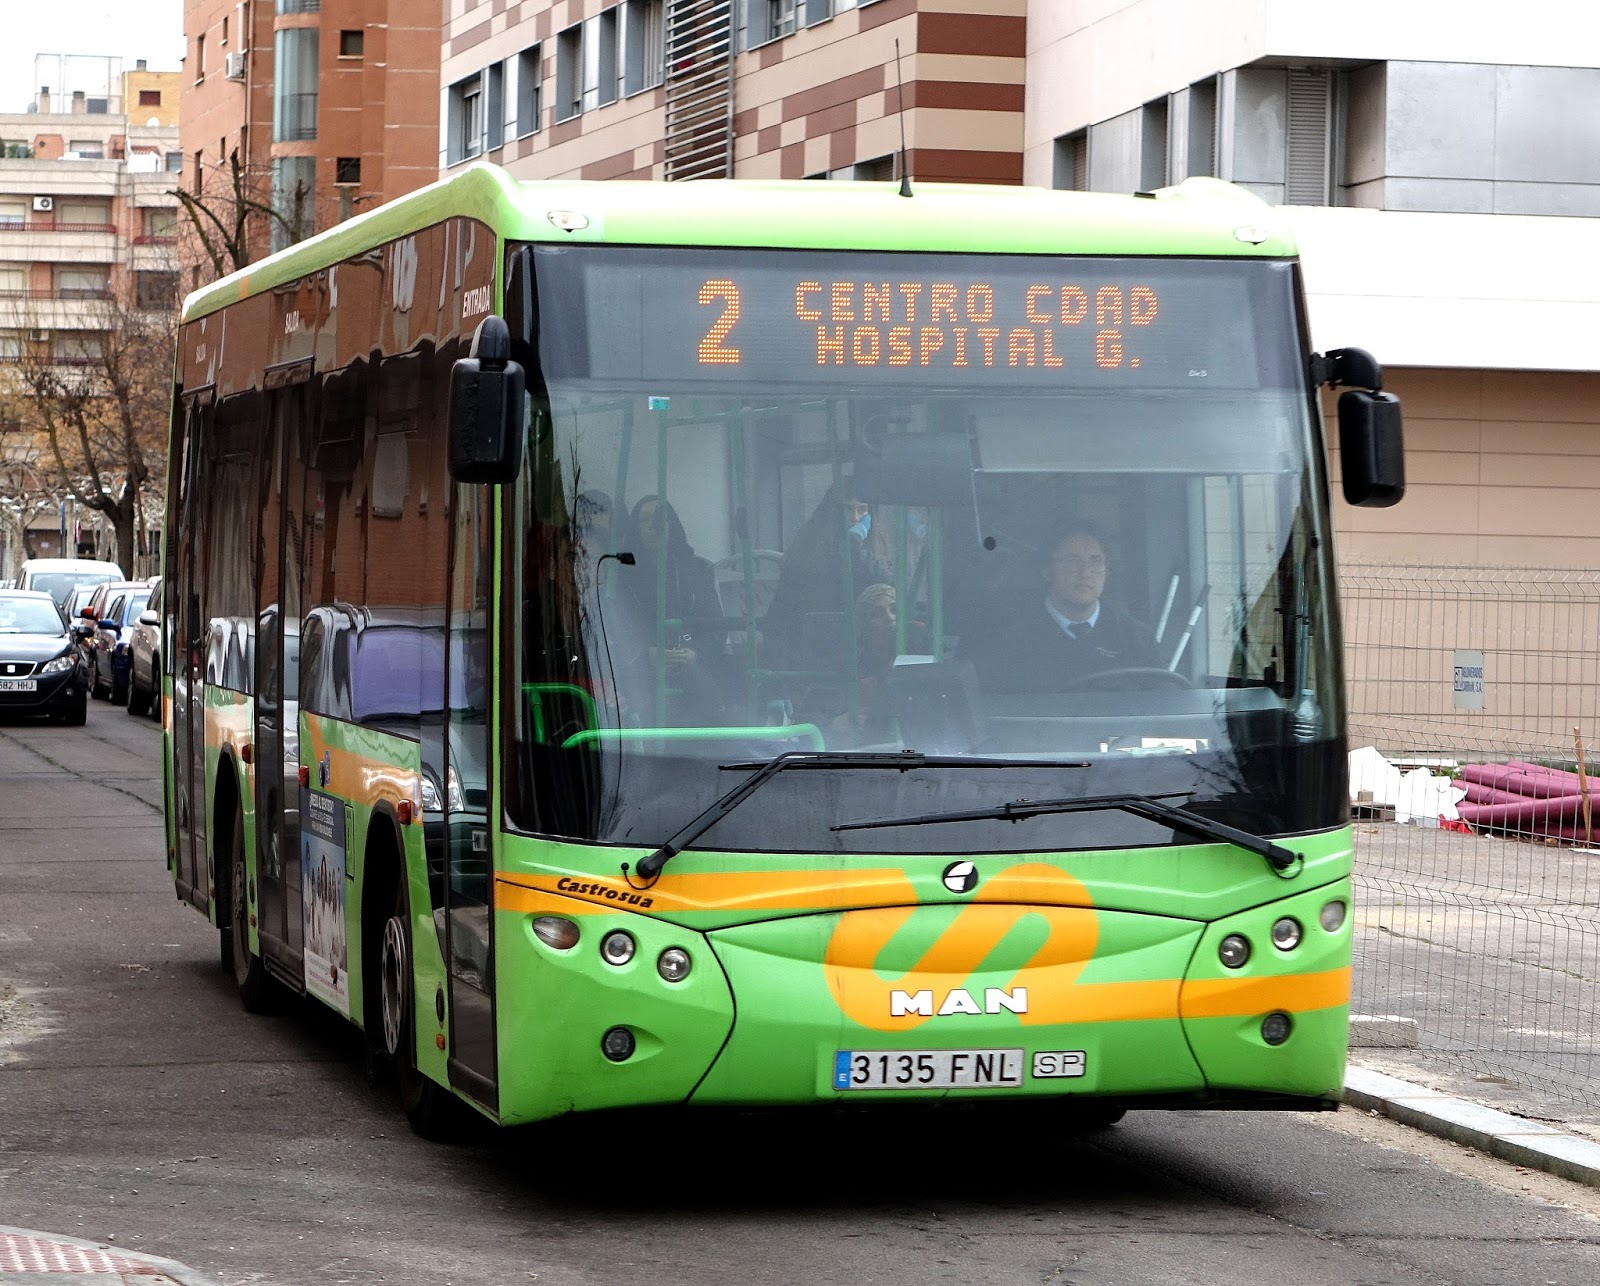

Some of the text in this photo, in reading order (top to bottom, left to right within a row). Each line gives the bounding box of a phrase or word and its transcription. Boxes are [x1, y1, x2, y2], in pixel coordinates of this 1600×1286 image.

[462, 284, 491, 318] ENTRADA
[795, 280, 1159, 326] CENTRO CDAD
[698, 279, 740, 364] 2
[816, 325, 1141, 368] HOSPITAL G.
[18, 682, 33, 690] HHJ
[557, 877, 654, 908] Castrosua
[890, 986, 1028, 1017] MAN
[838, 1053, 1017, 1084] E 3135 FNL
[1038, 1055, 1080, 1074] SP
